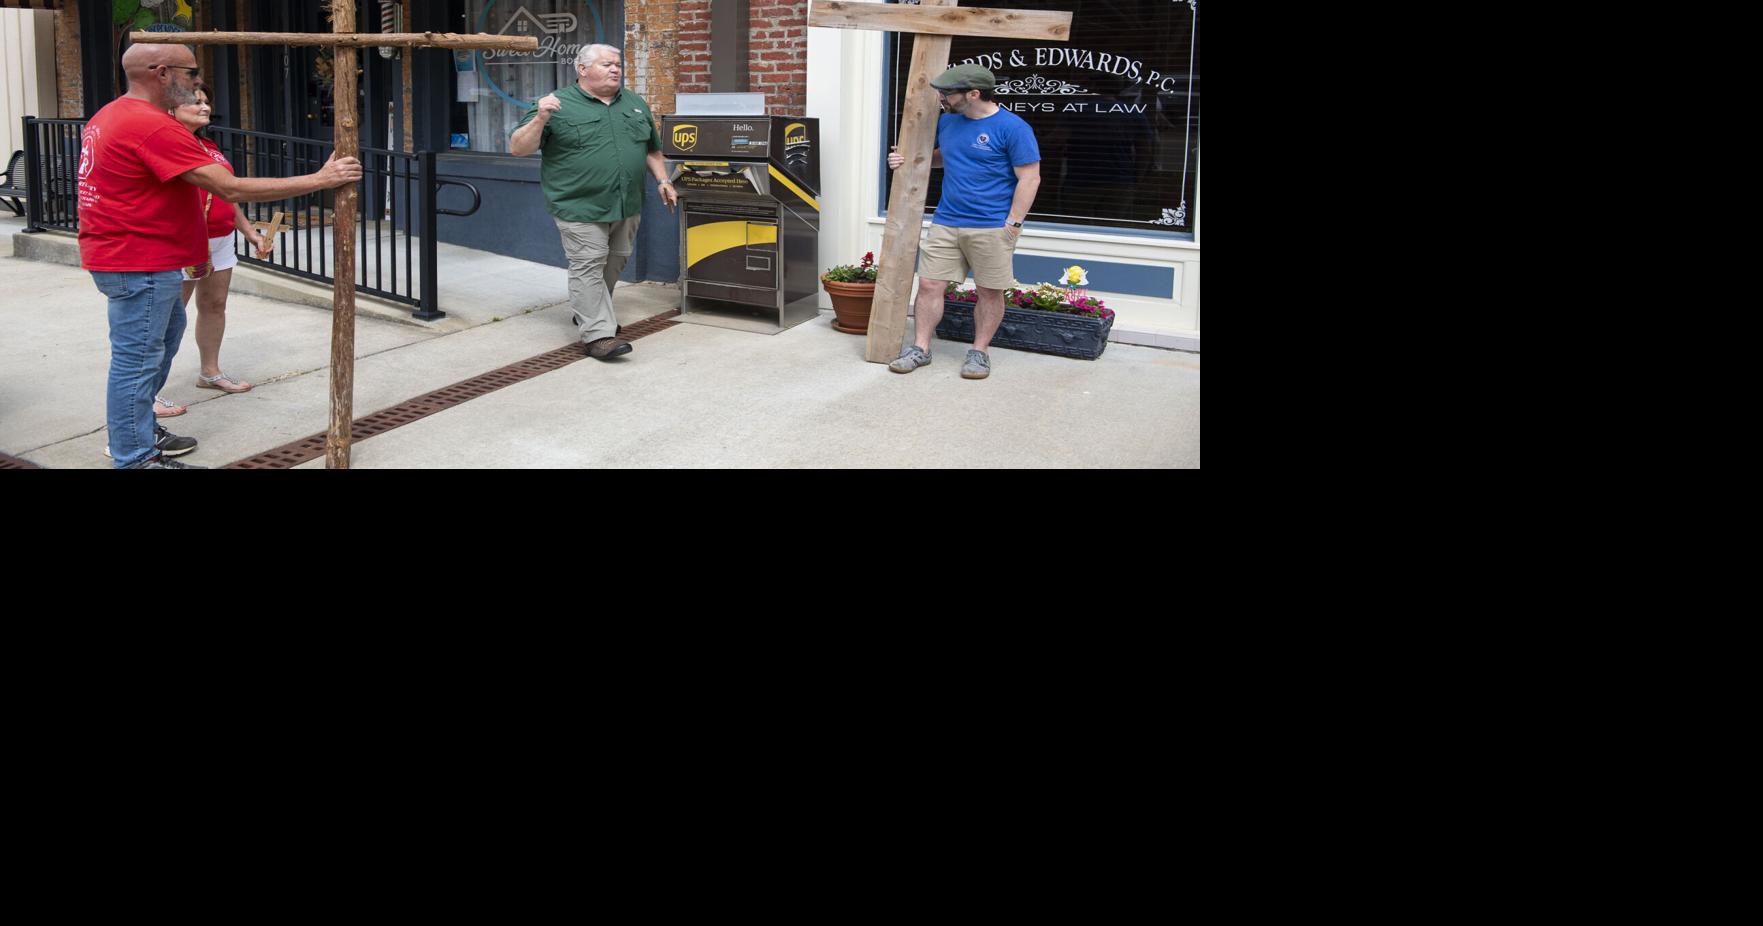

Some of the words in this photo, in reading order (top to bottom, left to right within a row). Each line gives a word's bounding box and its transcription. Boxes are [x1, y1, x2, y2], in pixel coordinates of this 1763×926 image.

[533, 36, 583, 58] Hom
[1009, 49, 1027, 67] &
[1034, 47, 1143, 84] EDWARDS,
[1145, 70, 1176, 94] P.C.
[1062, 102, 1090, 113] AT
[1095, 102, 1148, 114] LAW
[732, 123, 754, 132] Hello.
